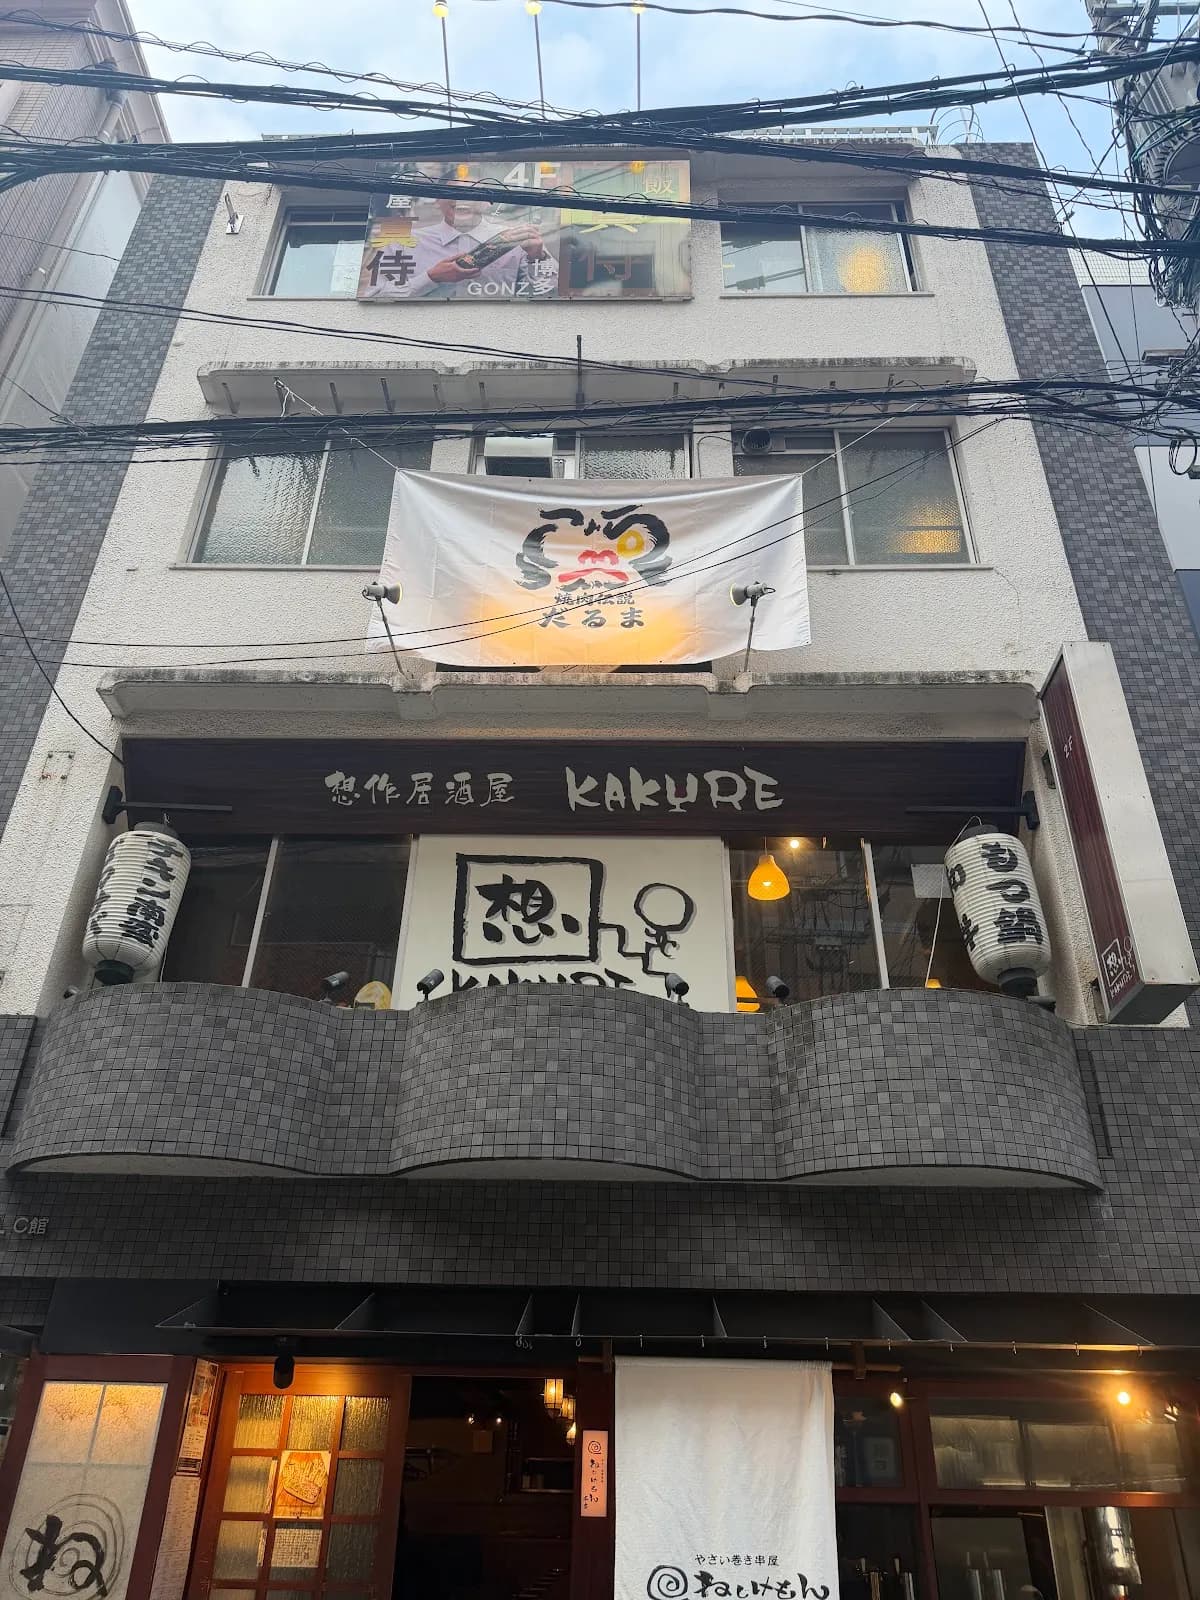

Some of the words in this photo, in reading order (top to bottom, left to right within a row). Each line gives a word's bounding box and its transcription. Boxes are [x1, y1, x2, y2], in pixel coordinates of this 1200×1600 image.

[504, 162, 561, 191] 4F
[467, 281, 530, 297] GONZ
[532, 258, 558, 296] 博多
[554, 592, 635, 606] 焼肉伝説
[537, 607, 645, 629] だるま
[324, 770, 516, 808] 想作居酒屋
[565, 765, 785, 813] KAKURE
[474, 873, 581, 945] 想
[980, 841, 1044, 945] もつ鍋
[694, 1553, 780, 1567] やさい巻き串屋
